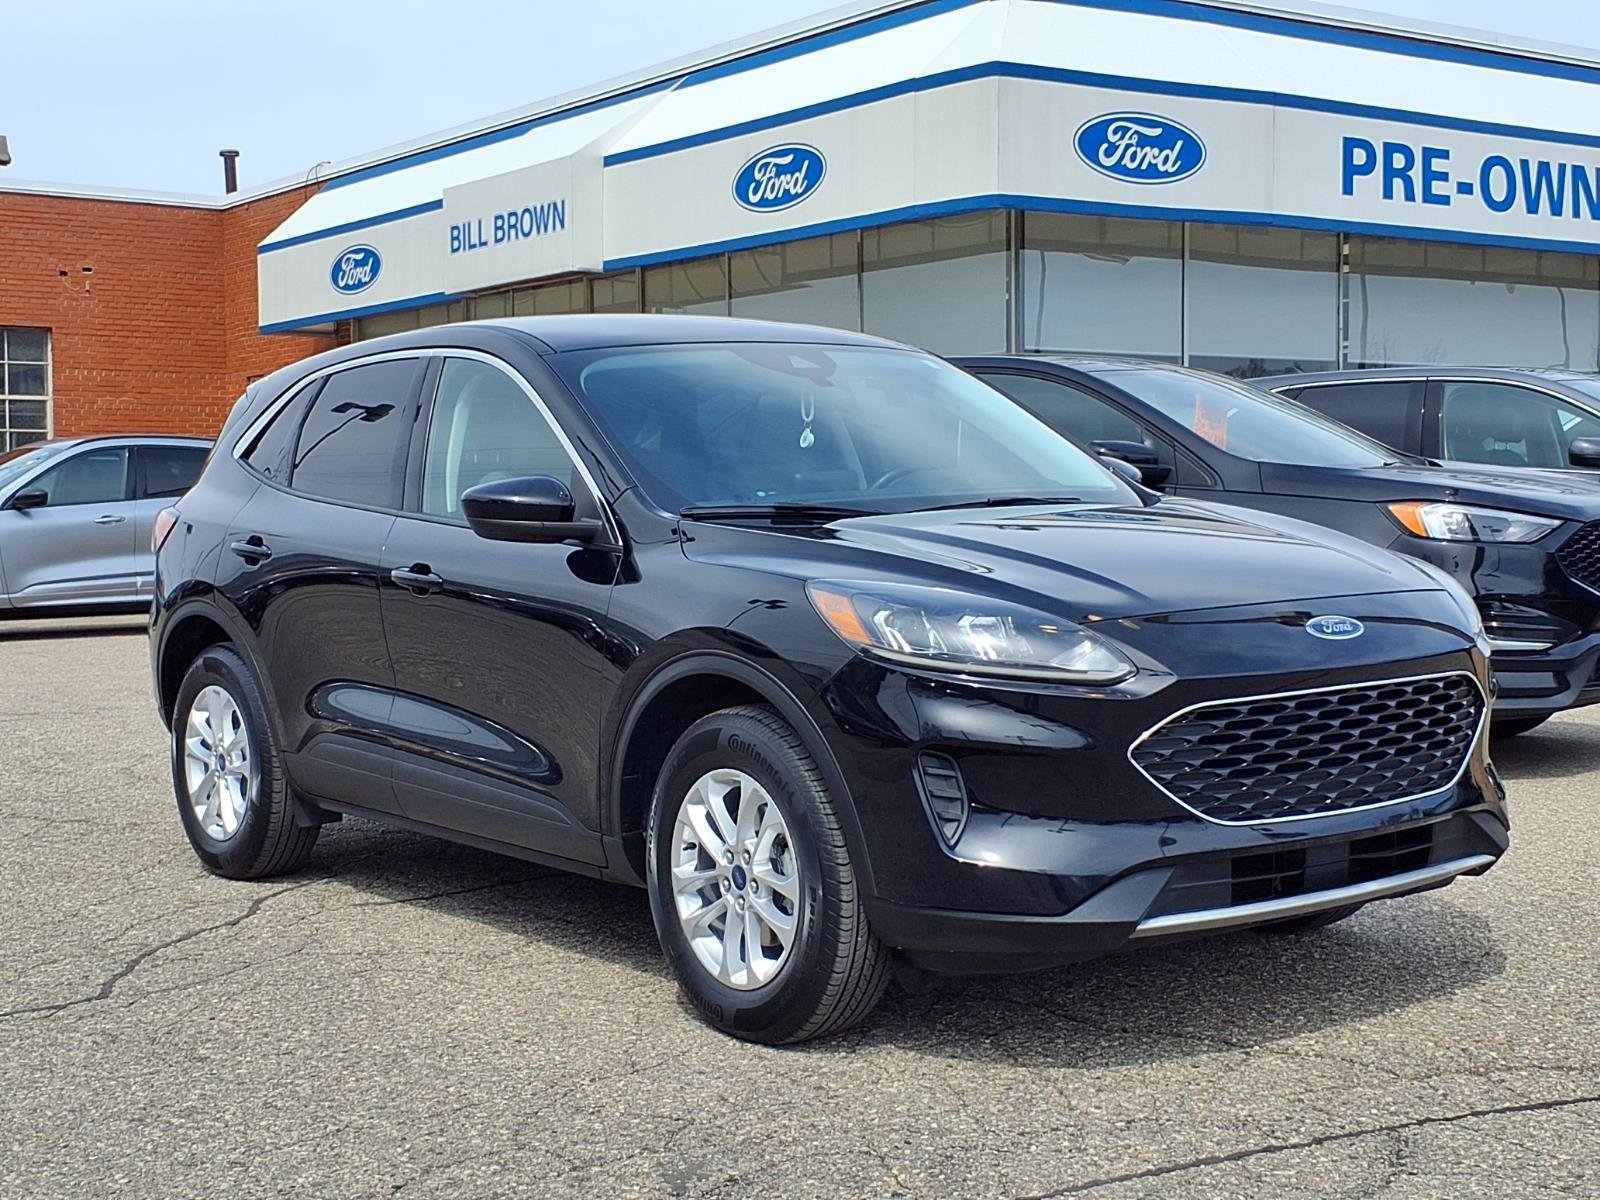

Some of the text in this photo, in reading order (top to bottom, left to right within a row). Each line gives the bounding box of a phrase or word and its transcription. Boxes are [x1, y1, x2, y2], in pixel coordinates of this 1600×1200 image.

[1098, 120, 1184, 173] Ford
[748, 153, 810, 204] Ford
[1341, 136, 1600, 221] PRE-OWN
[449, 199, 566, 254] BILL BROWN
[338, 252, 374, 288] Ford
[1321, 619, 1354, 634] Ford
